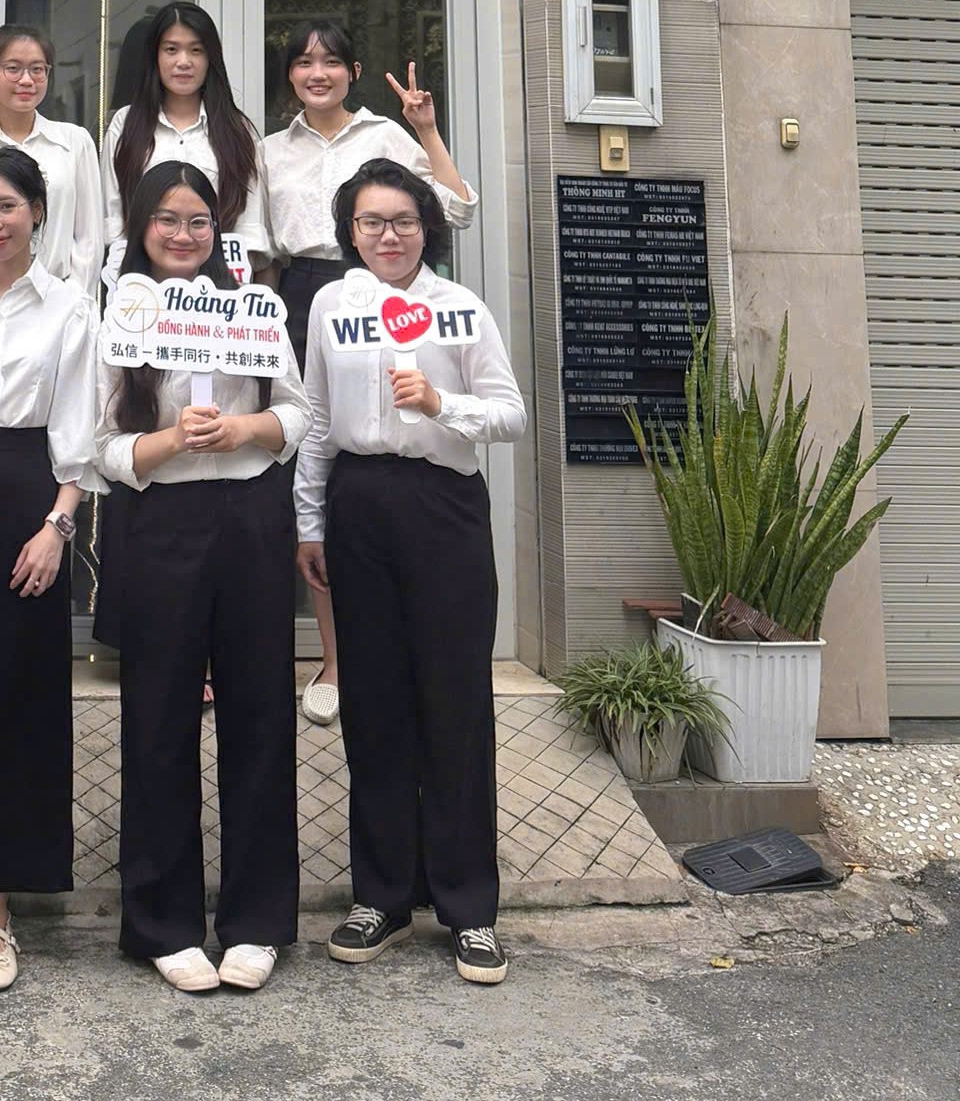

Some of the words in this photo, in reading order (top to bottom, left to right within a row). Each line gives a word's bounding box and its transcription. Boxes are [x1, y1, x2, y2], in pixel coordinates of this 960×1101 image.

[592, 189, 613, 197] MINH
[615, 190, 625, 198] HT
[684, 186, 700, 194] FOCUS
[642, 214, 696, 224] FENGYUN
[332, 316, 381, 344] WE
[387, 307, 429, 332] LOVE
[437, 310, 476, 338] HT
[185, 322, 210, 337] HÀNH
[213, 328, 224, 339] &
[228, 325, 250, 340] PHÁT
[254, 325, 280, 343] TRIỂN
